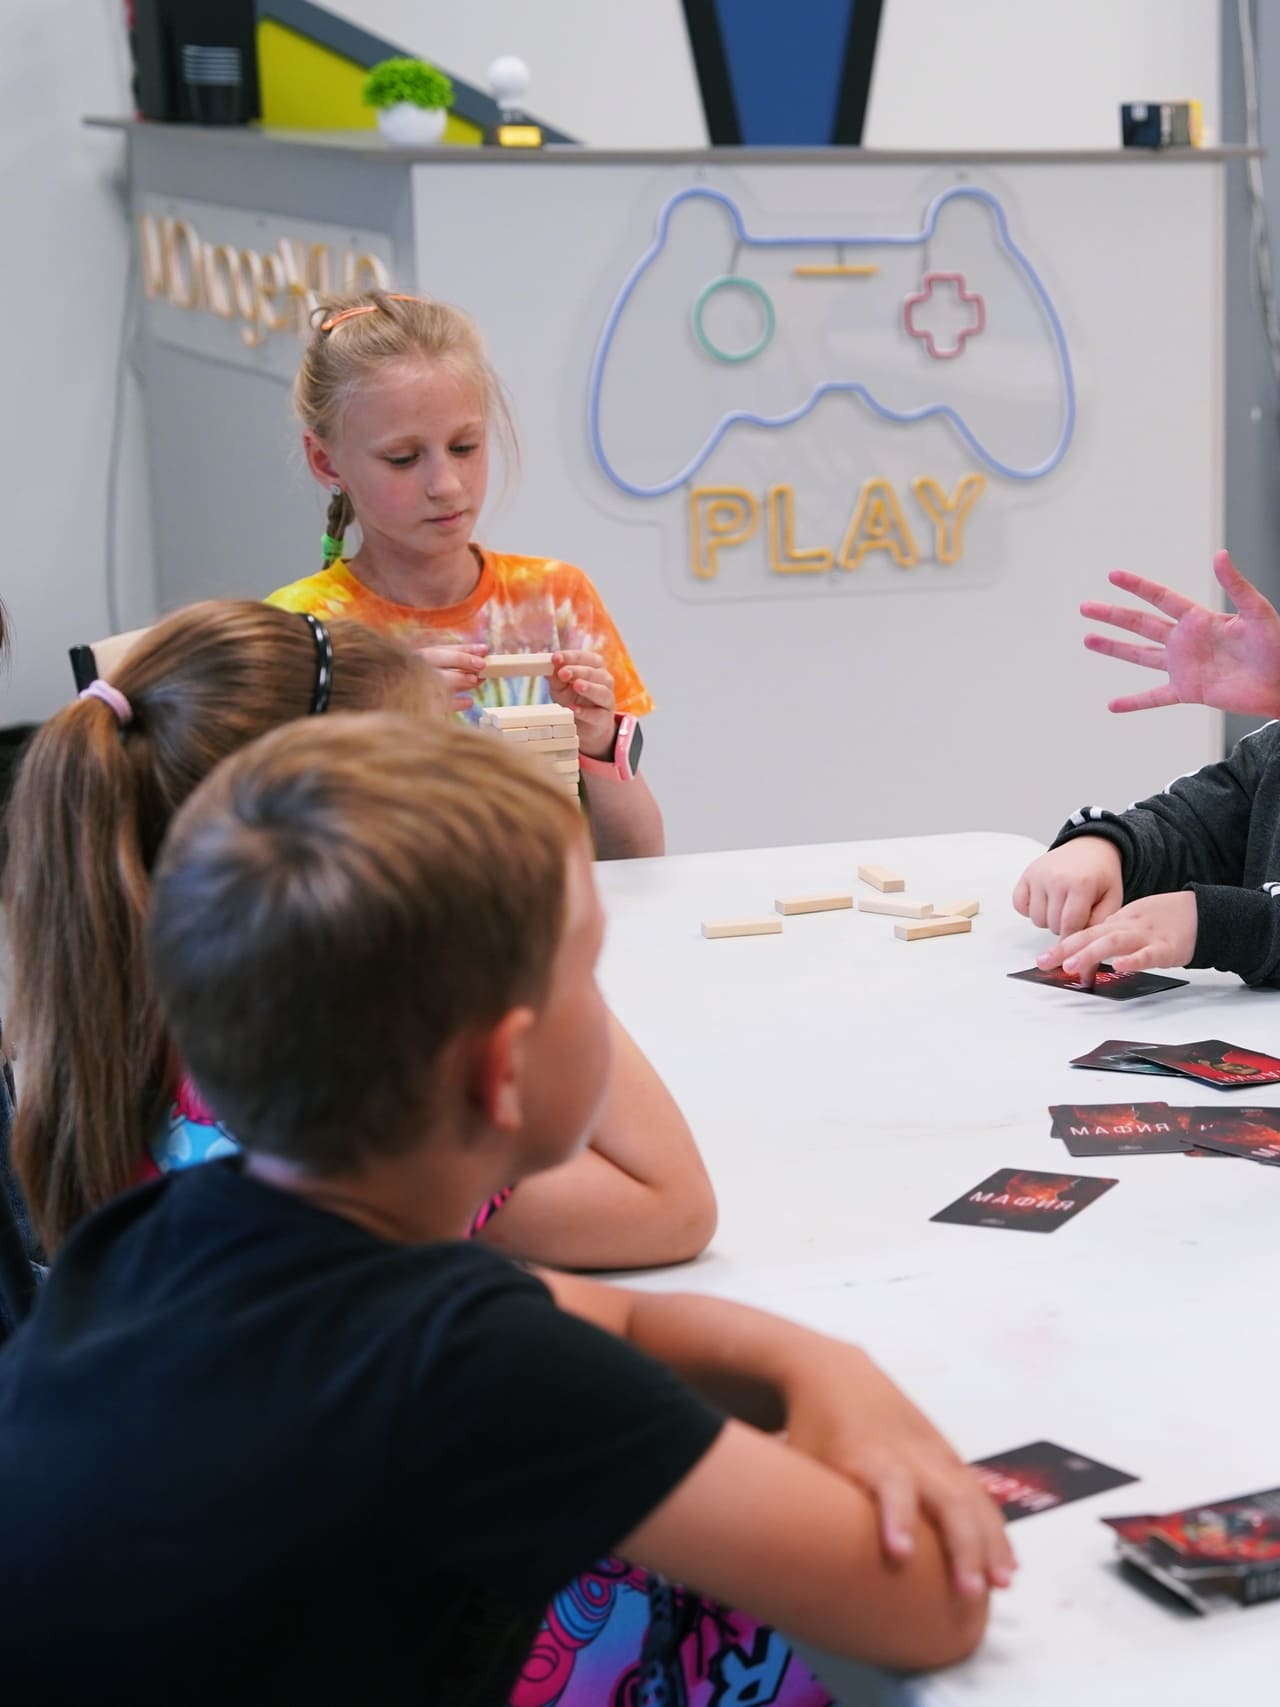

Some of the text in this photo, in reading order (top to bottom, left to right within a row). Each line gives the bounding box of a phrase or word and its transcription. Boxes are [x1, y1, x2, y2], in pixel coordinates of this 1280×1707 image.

[689, 473, 987, 579] PLAY
[1069, 1122, 1171, 1137] МАФИЯ
[968, 1190, 1076, 1211] МАФИЯ
